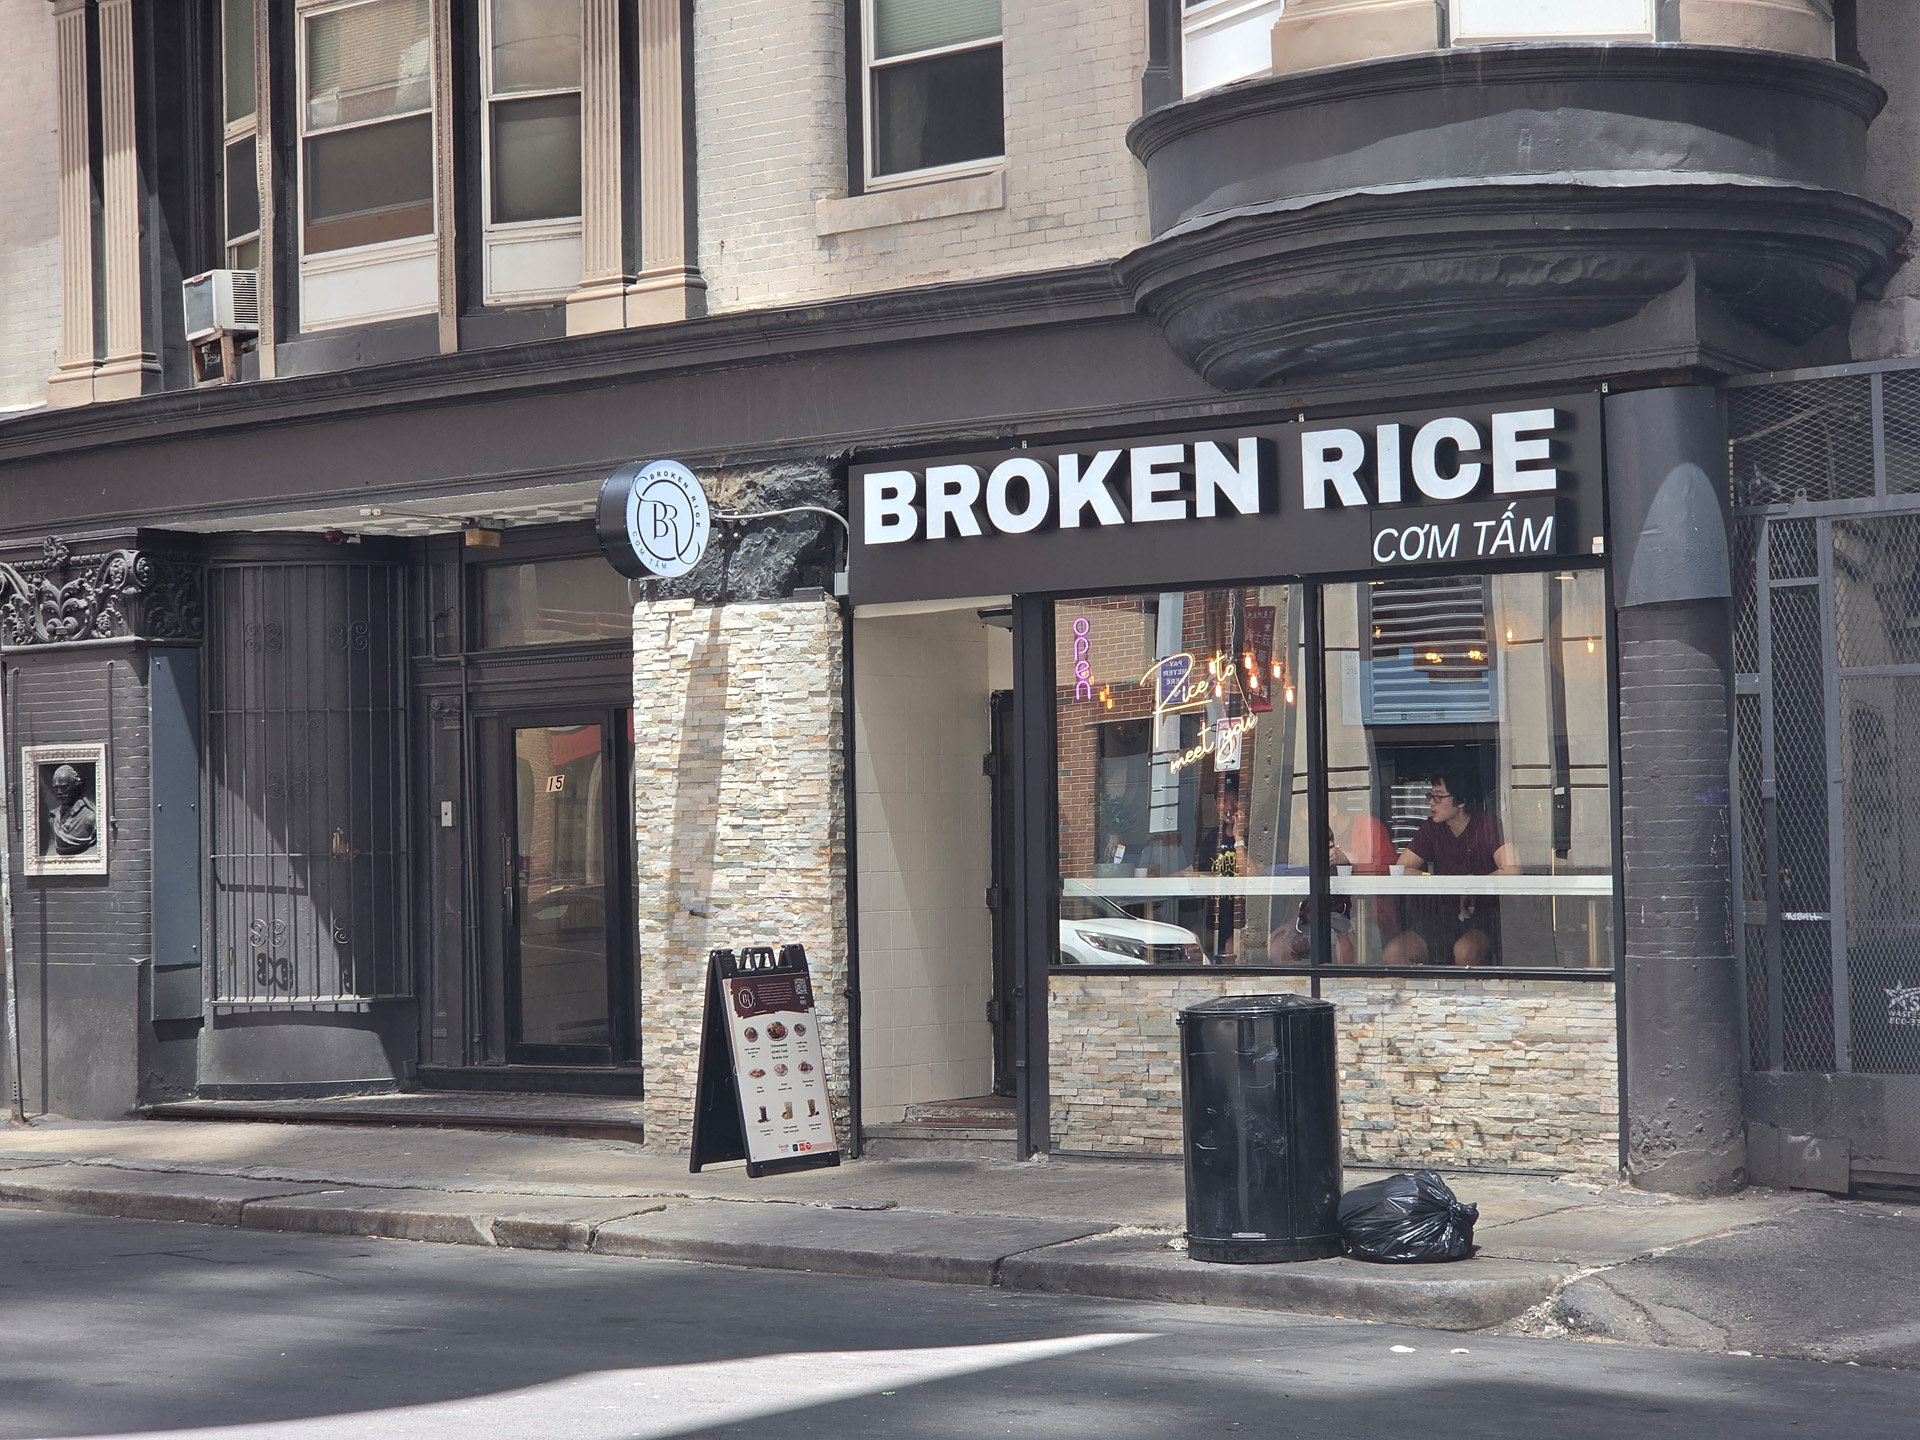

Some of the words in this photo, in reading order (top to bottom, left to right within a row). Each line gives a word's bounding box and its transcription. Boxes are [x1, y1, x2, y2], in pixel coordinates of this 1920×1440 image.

[650, 470, 689, 490] BROKEN
[691, 496, 701, 528] RICE
[864, 437, 1260, 546] BROKEN
[1301, 408, 1558, 510] RICE
[1372, 522, 1460, 564] CƠM
[1472, 501, 1554, 555] TẤM
[1072, 616, 1092, 700] open
[1139, 652, 1213, 749] Rice
[1214, 648, 1236, 681] to
[1169, 725, 1216, 774] meet
[1216, 714, 1258, 765] you
[548, 775, 563, 791] 15
[1888, 1010, 1918, 1019] WASTE
